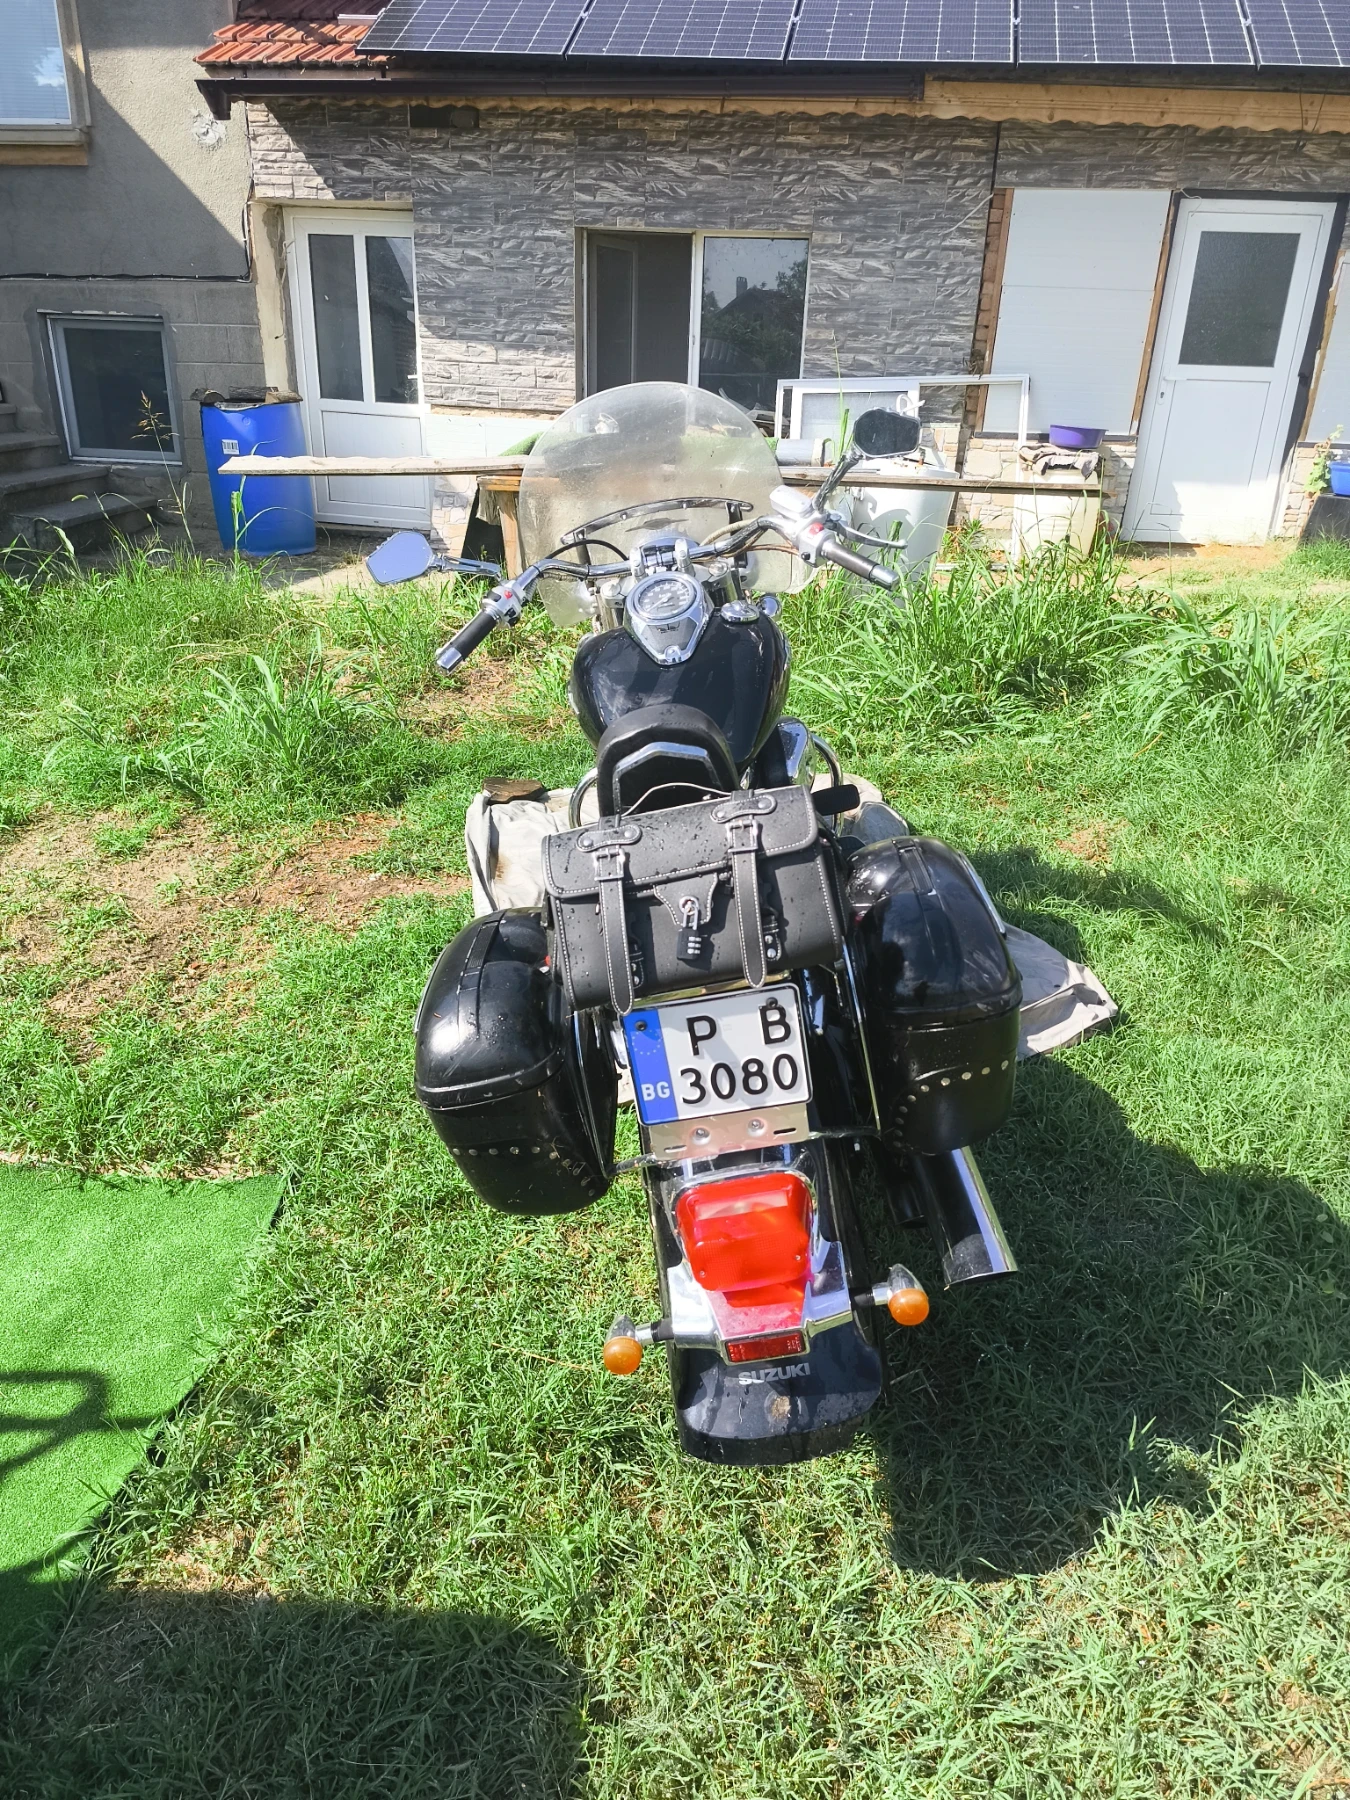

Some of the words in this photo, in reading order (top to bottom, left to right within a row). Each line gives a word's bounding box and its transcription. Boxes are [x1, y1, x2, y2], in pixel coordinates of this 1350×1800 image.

[686, 1015, 717, 1056] P
[759, 1005, 791, 1045] B
[641, 1081, 671, 1101] BG
[680, 1053, 798, 1105] 3080
[738, 1362, 811, 1385] SUZUKI
